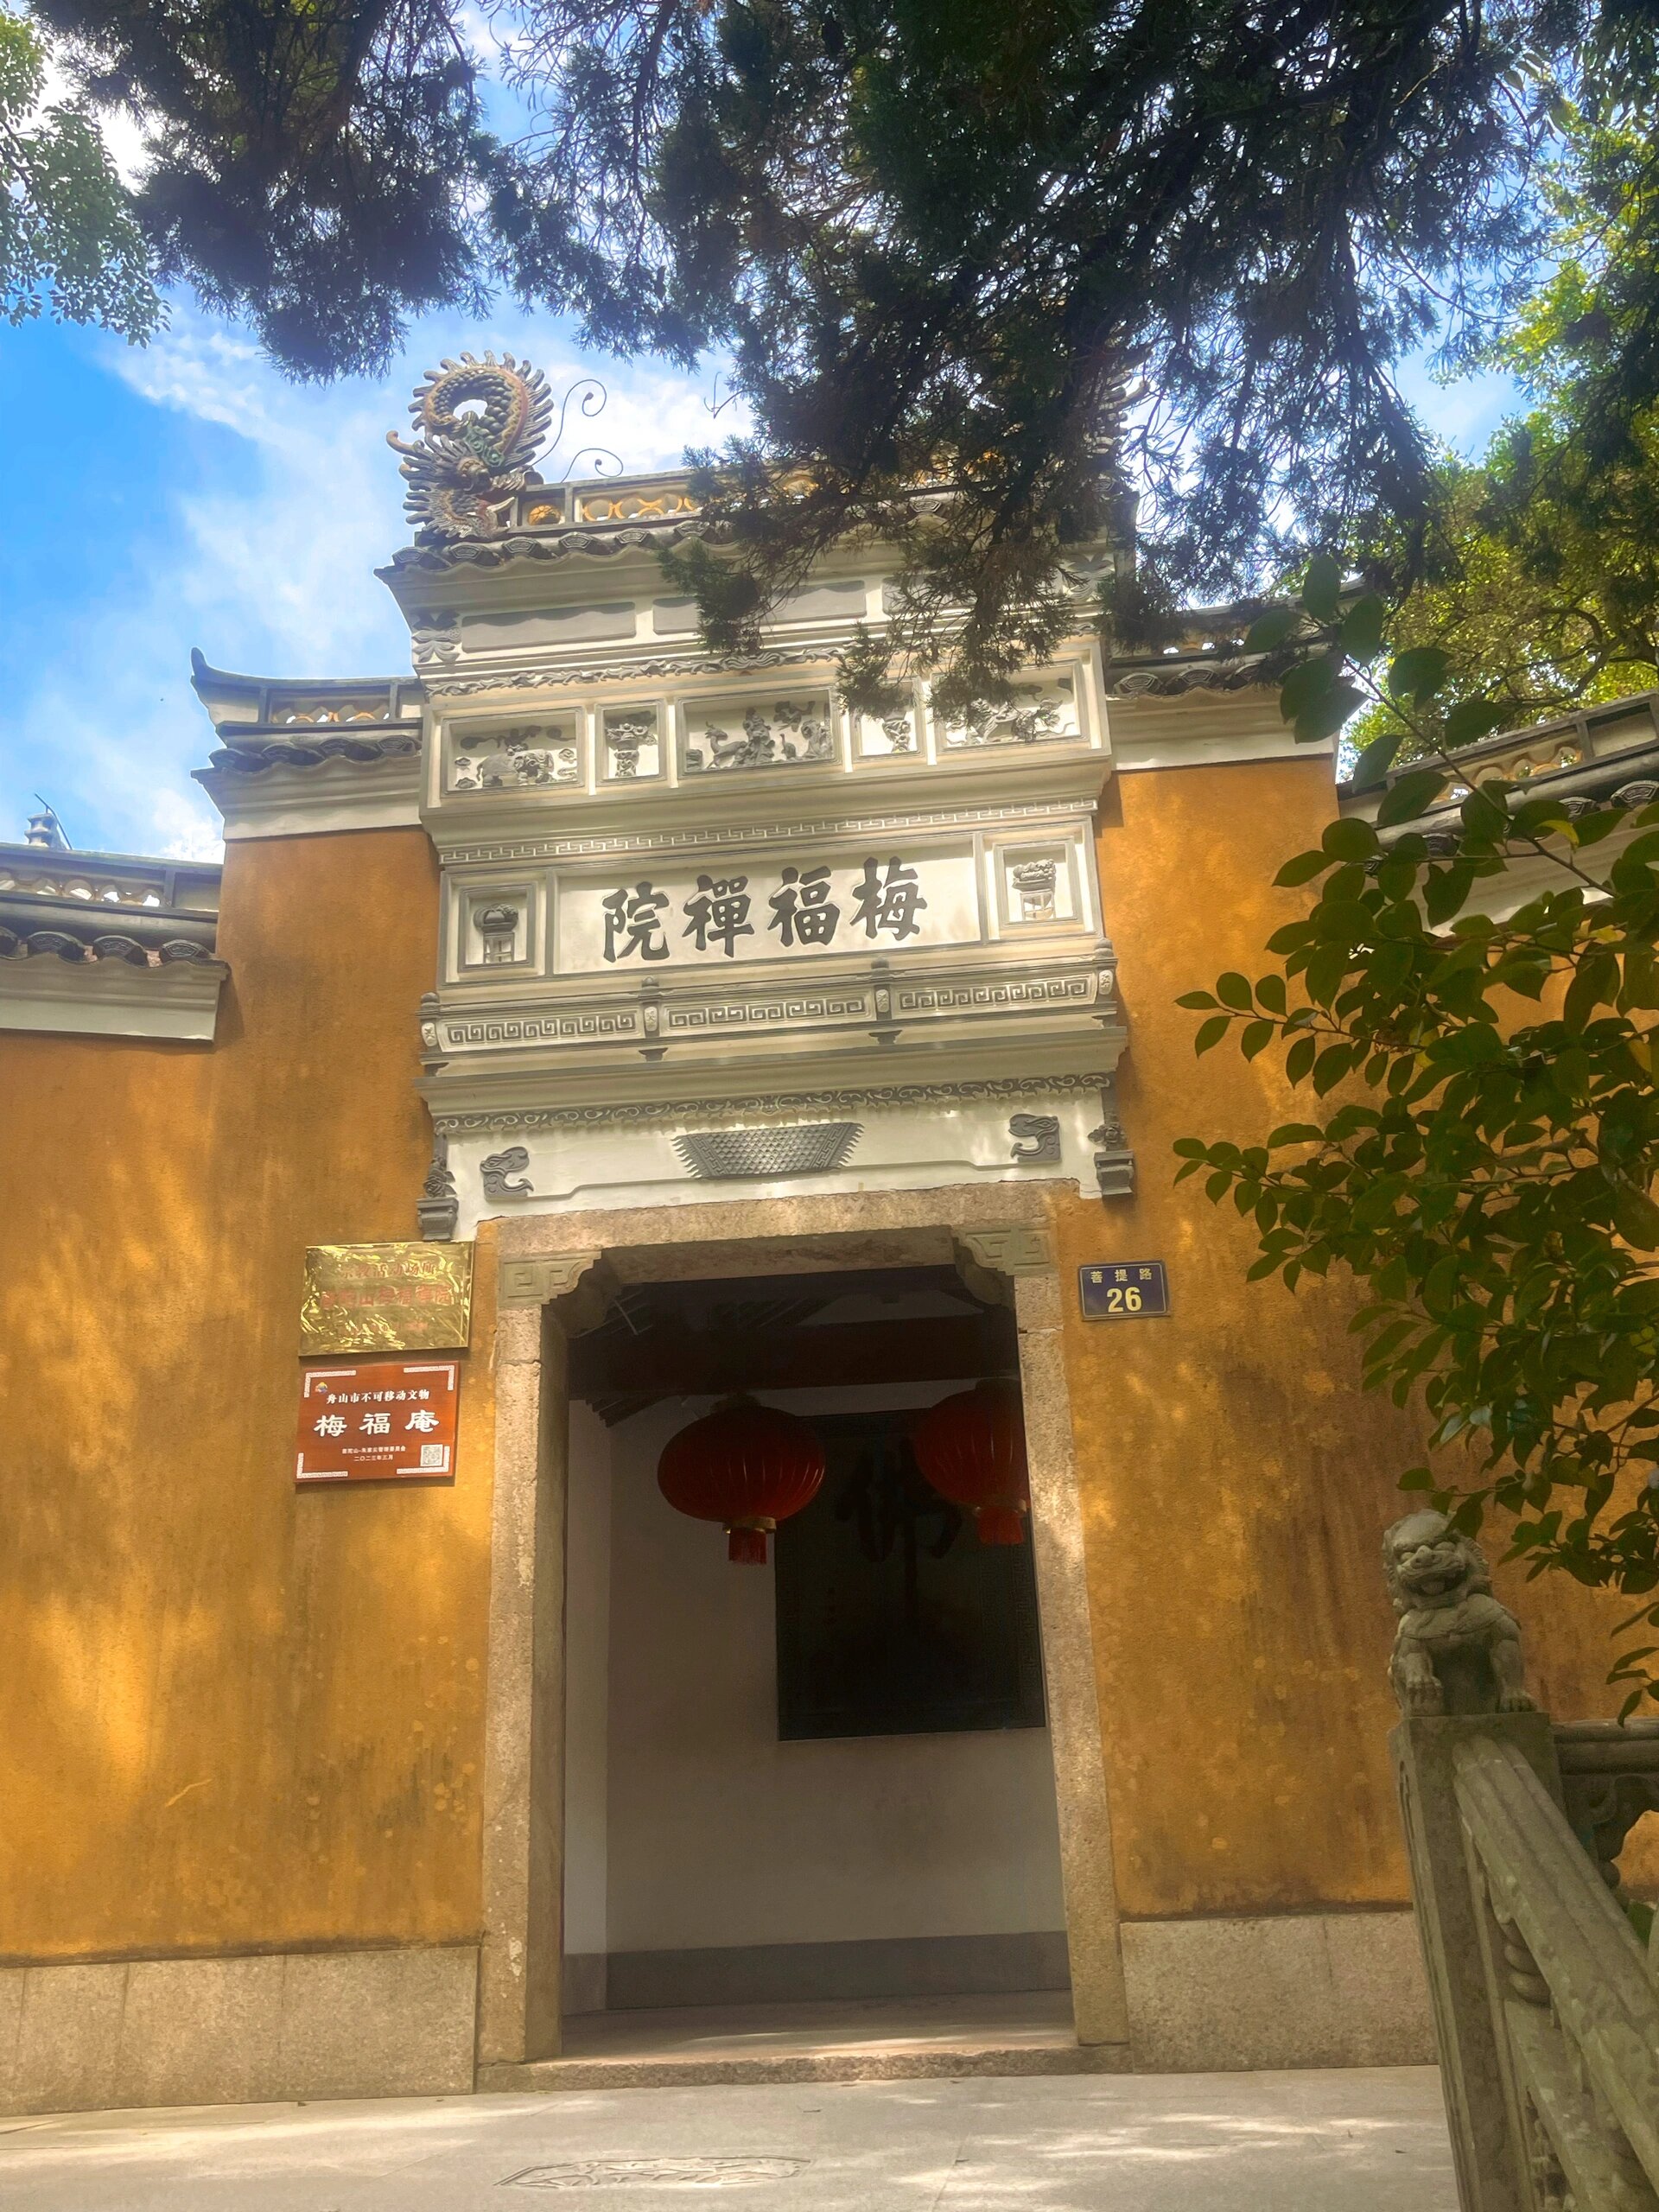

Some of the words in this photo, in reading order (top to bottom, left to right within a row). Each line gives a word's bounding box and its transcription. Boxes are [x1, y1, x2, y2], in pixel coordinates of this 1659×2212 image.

[1090, 1268, 1152, 1283] 菩提路
[1107, 1287, 1141, 1313] 26
[326, 1389, 429, 1404] 舟山市不可移动文物
[314, 1409, 439, 1437] 梅福庵
